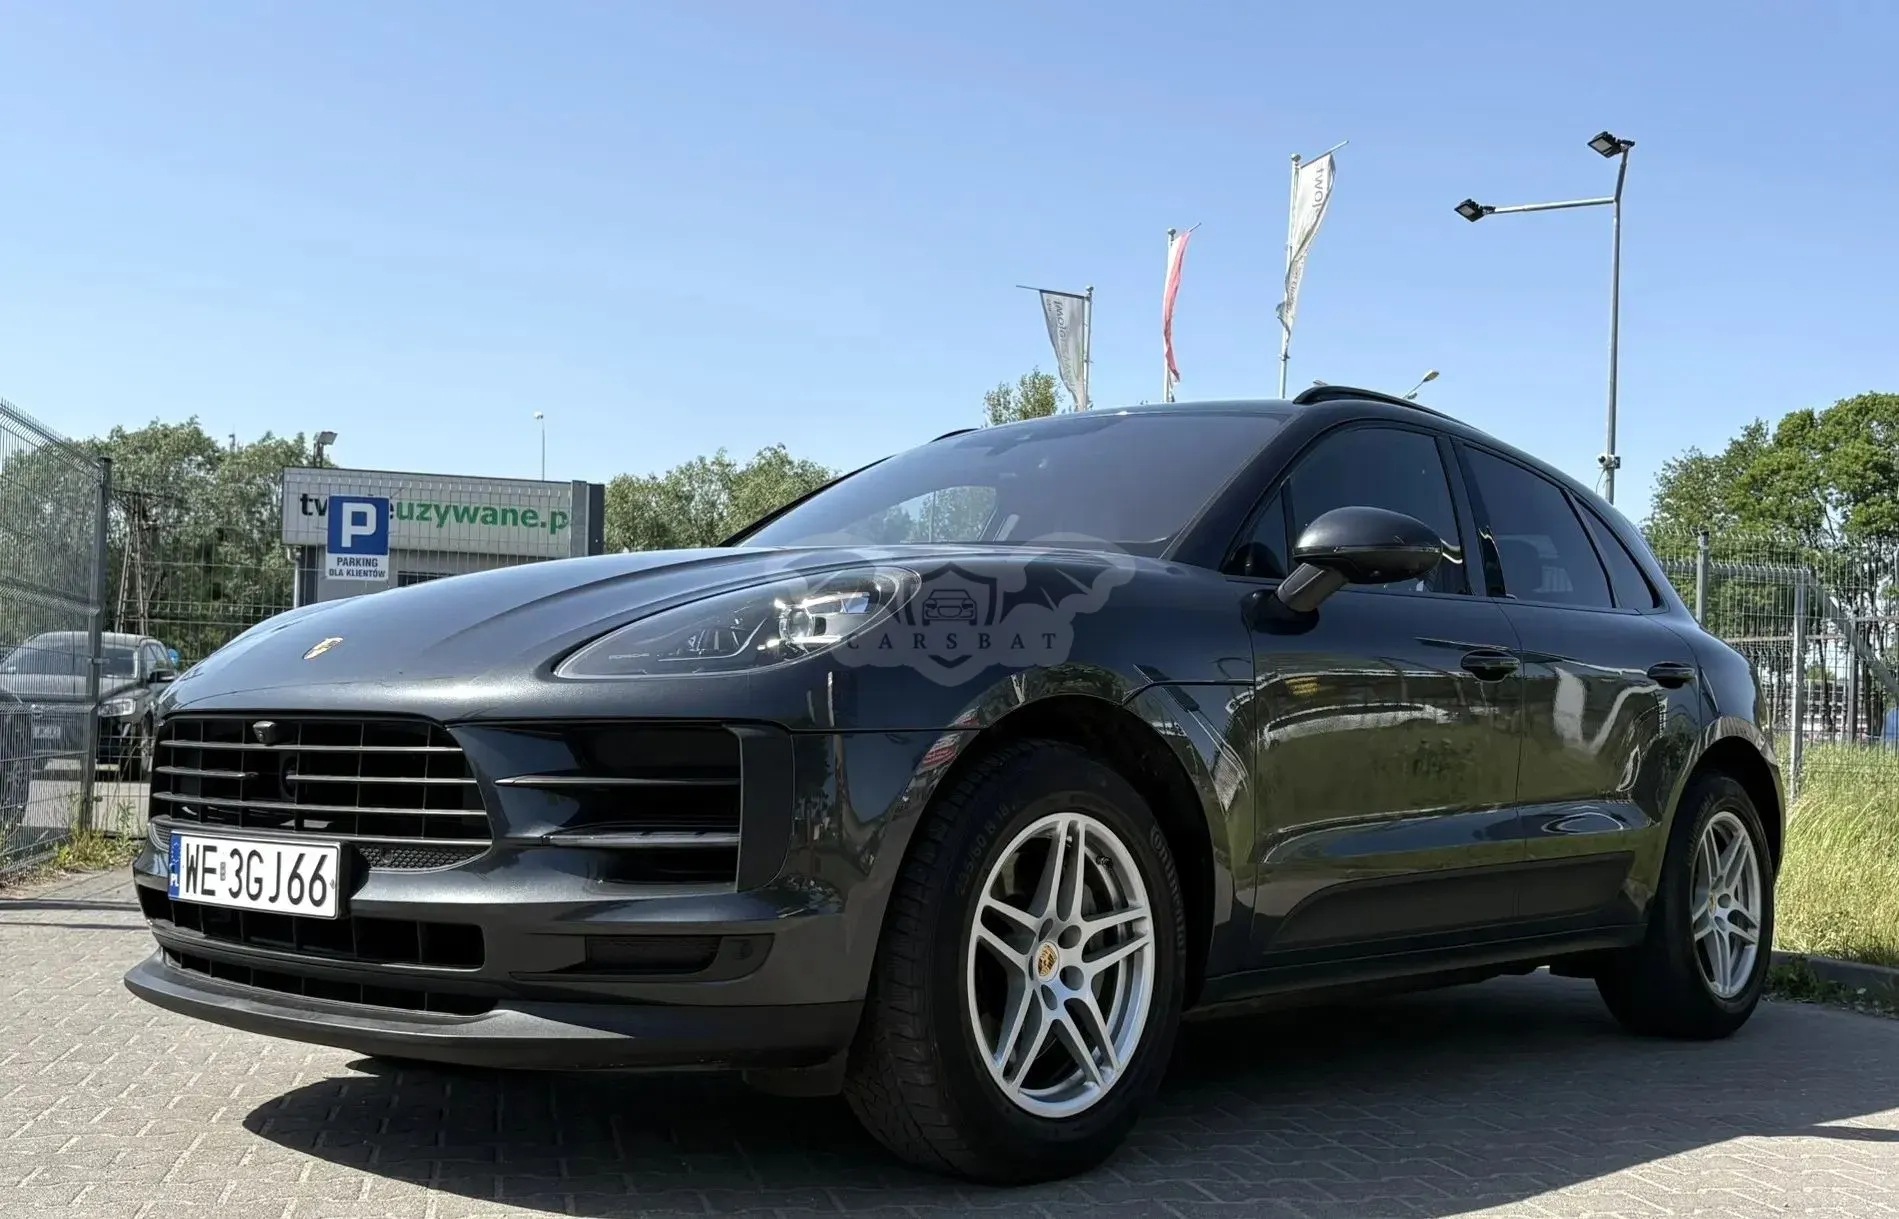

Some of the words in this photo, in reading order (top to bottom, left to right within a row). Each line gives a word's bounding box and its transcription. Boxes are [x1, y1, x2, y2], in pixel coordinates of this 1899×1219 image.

[342, 502, 377, 547] P
[337, 557, 378, 567] PARKING
[346, 567, 386, 577] KLIENTÓW
